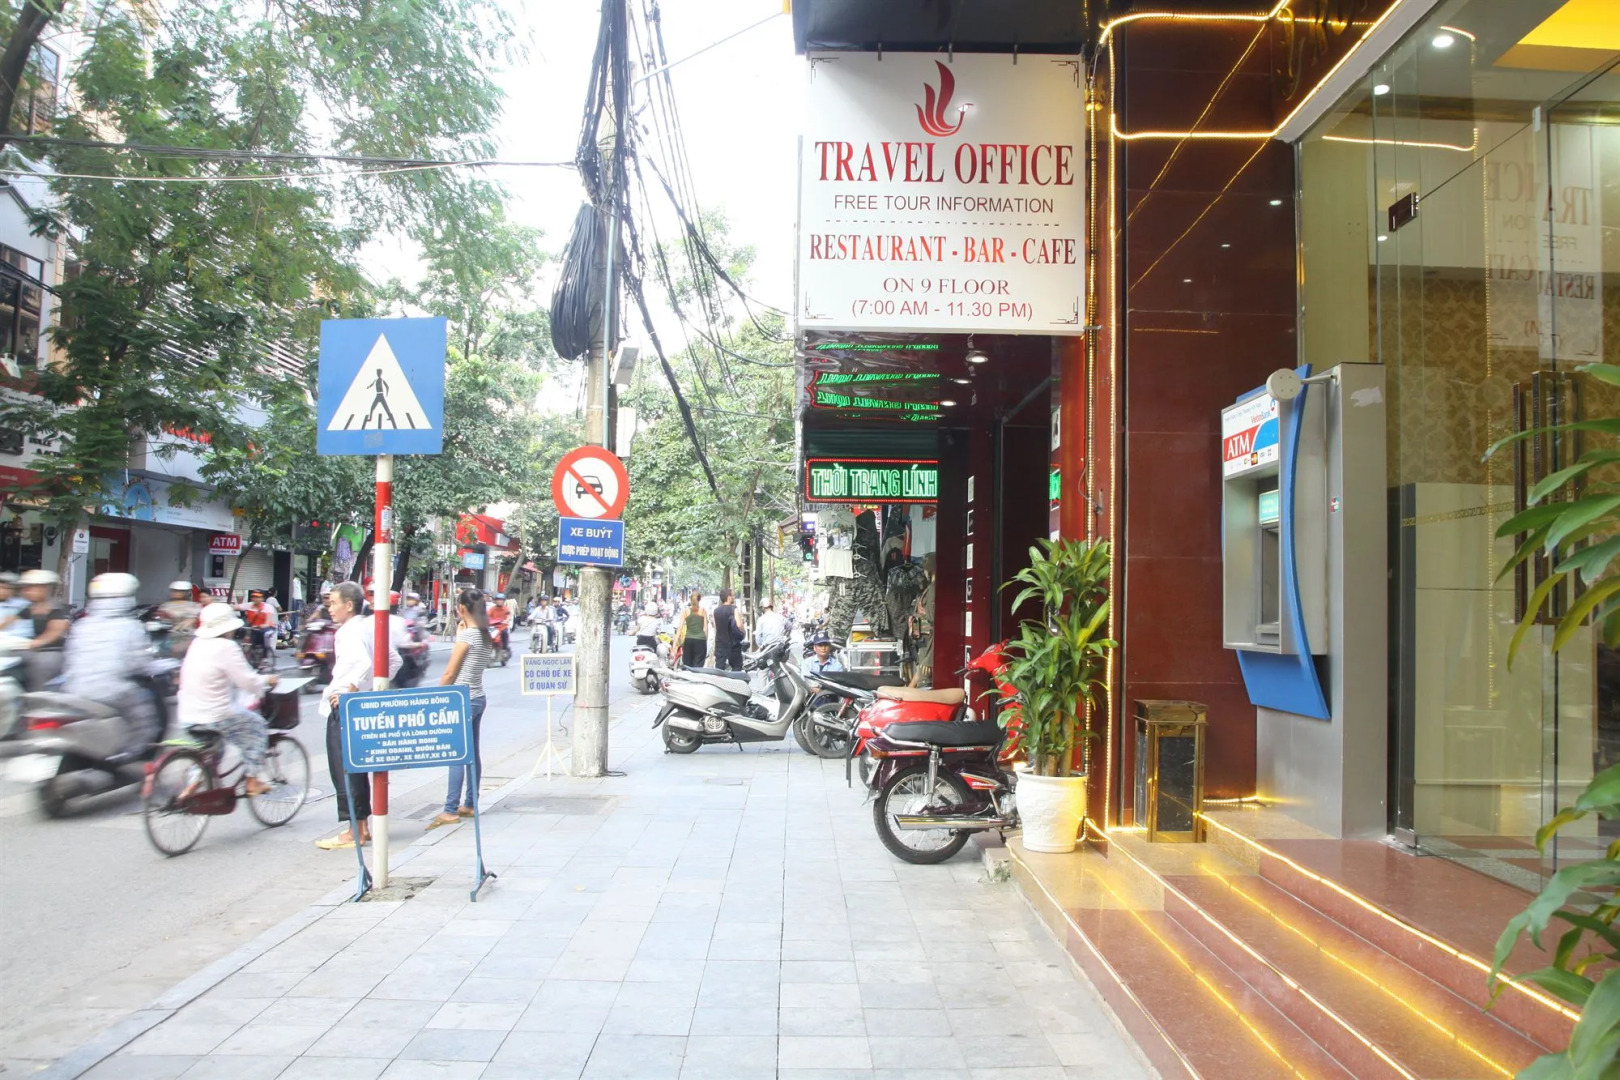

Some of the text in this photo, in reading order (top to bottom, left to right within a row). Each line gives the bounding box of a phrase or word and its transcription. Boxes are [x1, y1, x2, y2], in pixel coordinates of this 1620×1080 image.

[814, 141, 1074, 186] TRAVEL OFFICE
[834, 195, 1054, 213] FREE TOUR INFORMATION
[810, 234, 1076, 265] RESTAURANT BAR CAFE
[883, 278, 1010, 295] ON 9 FLOOR
[852, 300, 898, 318] (7:00
[900, 300, 928, 316] AM
[947, 302, 992, 318] 11.30
[998, 302, 1033, 321] PM)
[1227, 432, 1250, 460] ATM
[811, 463, 937, 498] THỜI TRANG LÍNH
[212, 537, 237, 547] ATM
[570, 526, 613, 538] XE BUÝT
[576, 544, 590, 556] PHÉP
[353, 706, 460, 730] TUYẾN PHỐ CẤM
